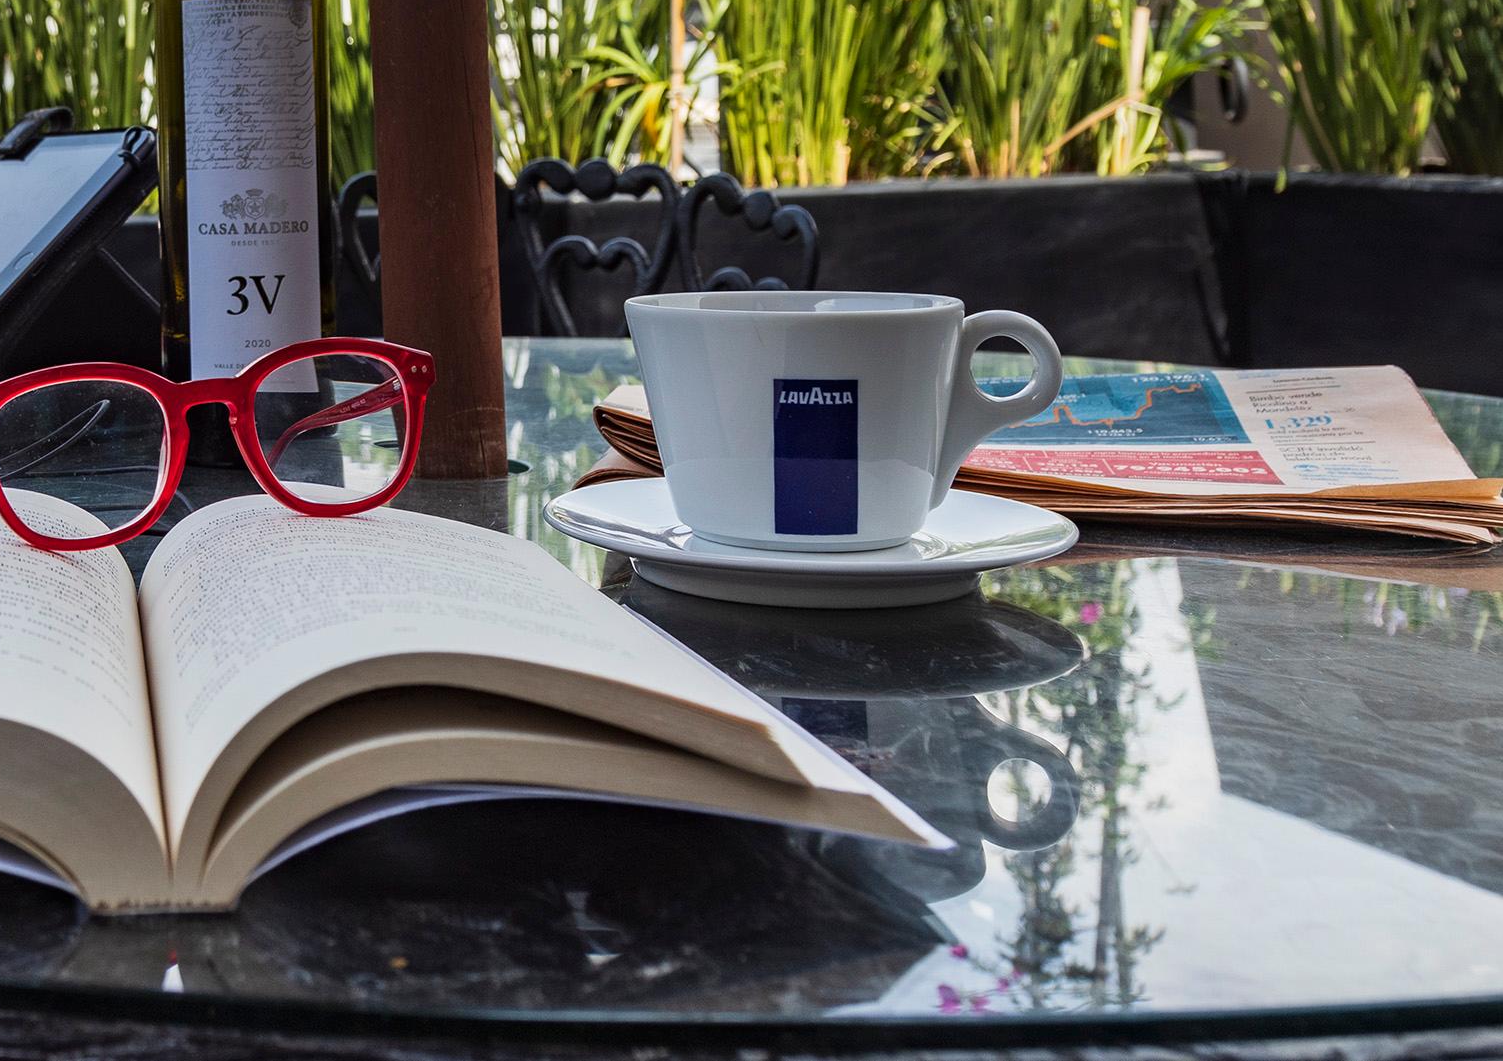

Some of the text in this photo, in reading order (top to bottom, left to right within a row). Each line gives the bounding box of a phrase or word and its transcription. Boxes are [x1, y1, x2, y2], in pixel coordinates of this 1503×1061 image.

[198, 220, 309, 235] CASA MADERO
[226, 274, 286, 315] 3V
[244, 339, 271, 348] 2020
[779, 387, 853, 404] LAVAZZA
[1249, 391, 1323, 402] Bimbo vende
[1265, 415, 1332, 429] 1,329
